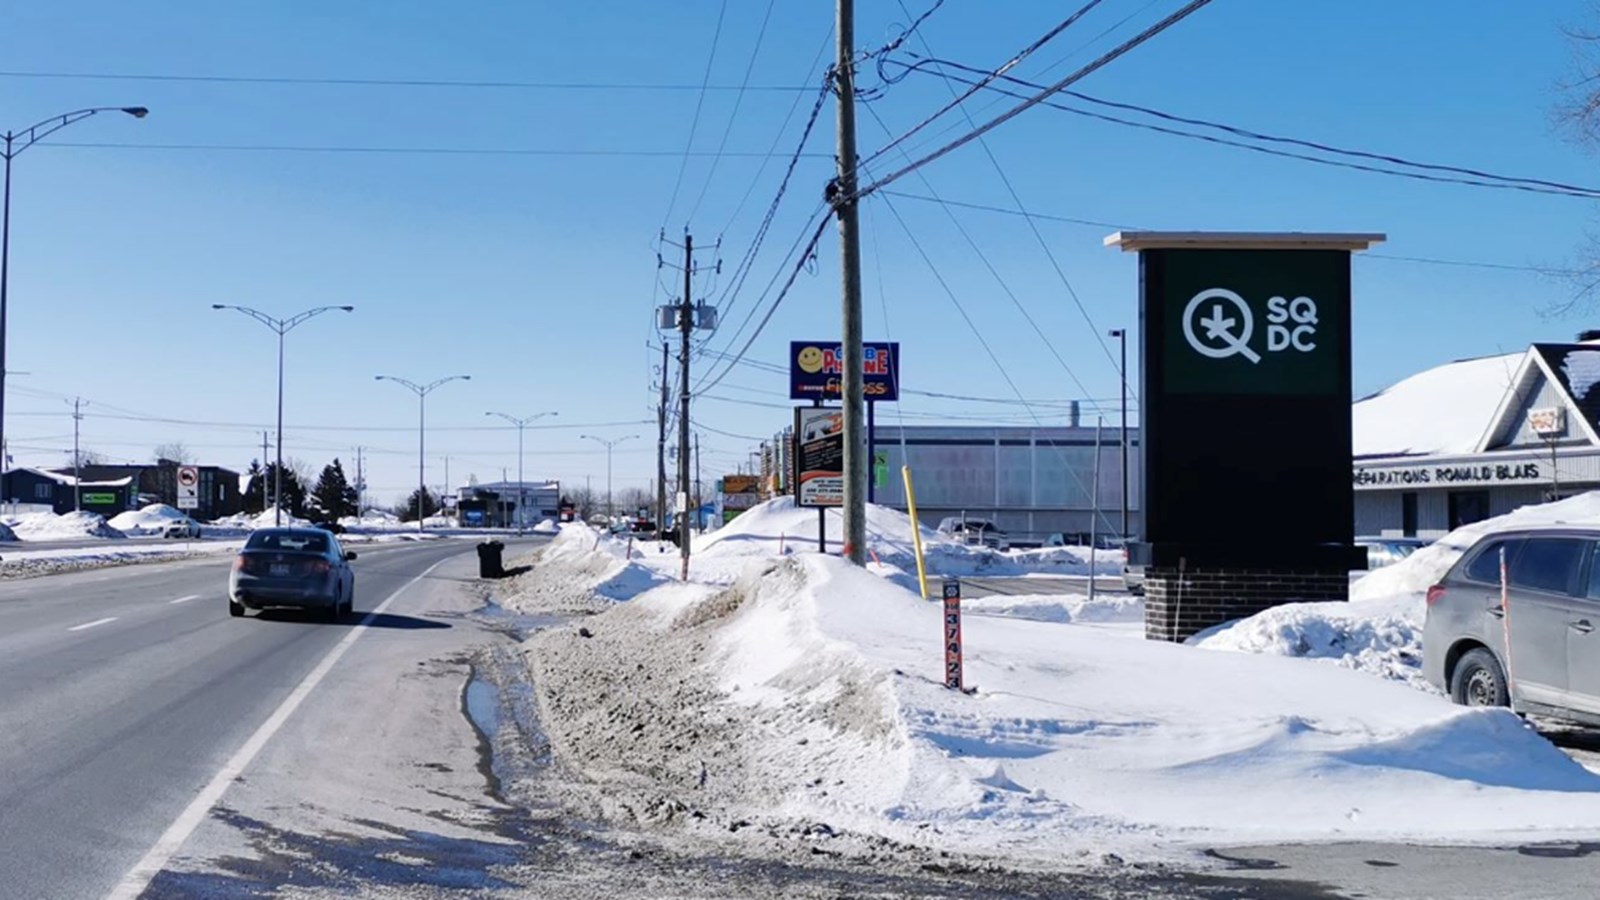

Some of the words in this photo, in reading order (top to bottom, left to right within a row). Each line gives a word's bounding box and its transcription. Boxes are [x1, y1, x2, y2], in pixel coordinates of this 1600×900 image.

[1266, 296, 1319, 325] SQ
[1267, 324, 1317, 352] DC
[1435, 466, 1492, 482] RONALD
[1496, 463, 1539, 480] BLAIS
